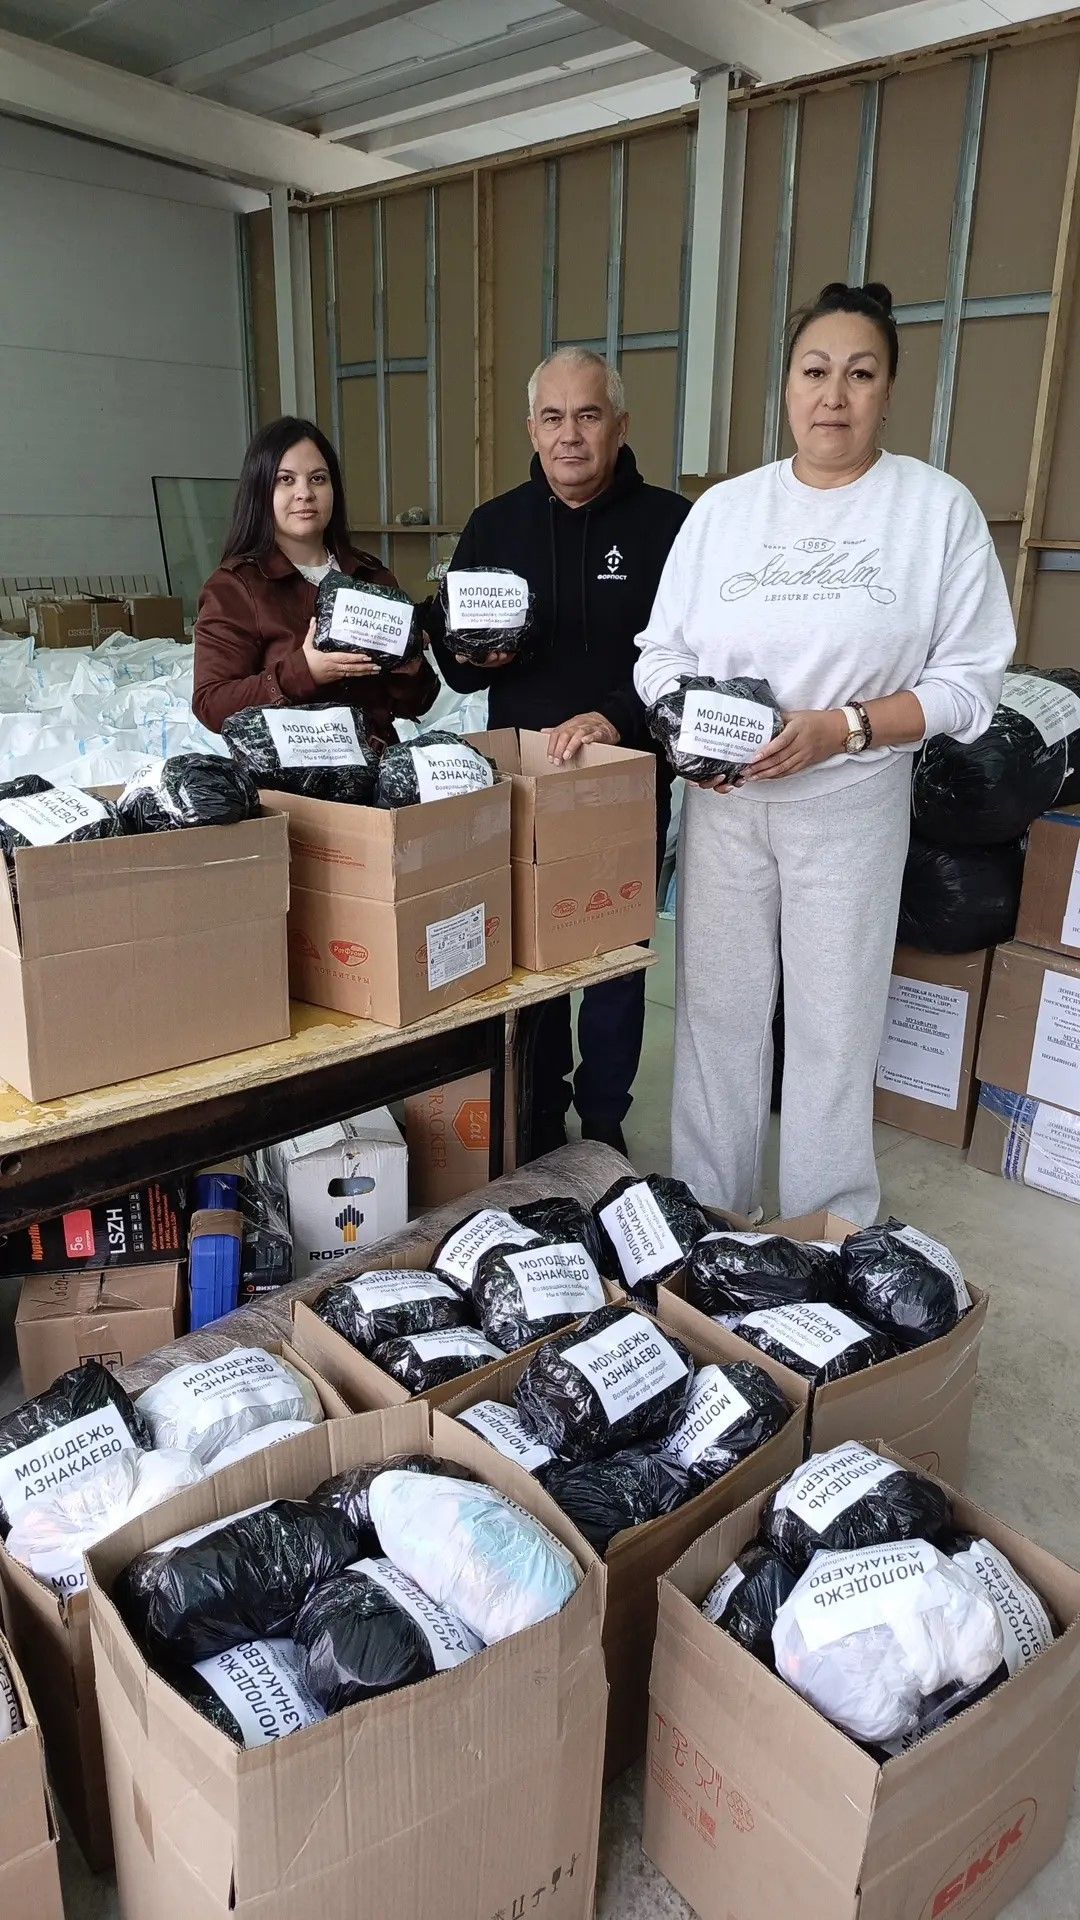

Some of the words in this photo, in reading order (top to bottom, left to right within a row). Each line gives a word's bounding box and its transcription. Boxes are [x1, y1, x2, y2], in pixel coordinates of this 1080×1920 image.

[802, 541, 827, 550] 1985
[459, 586, 522, 598] МОЛОДЕЖЬ
[726, 548, 888, 600] Stockholm
[344, 604, 404, 626] МОЛОДЕЖЬ
[459, 598, 522, 609] АЗНАКАЕВО
[764, 593, 809, 603] LEISURE
[812, 592, 841, 601] CLUB
[342, 616, 402, 637] АЗНАКАЕВО
[282, 722, 349, 735] МОЛОДЕЖЬ
[287, 733, 353, 745] АЗНАКАЕВО
[694, 722, 763, 744] АЗНАКАЕВО
[696, 708, 765, 731] МОЛОДЕЖЬ
[427, 758, 489, 777] МОЛОДЕЖЬ
[70, 1236, 83, 1251] 5e
[106, 1208, 126, 1254] LSZH
[445, 1213, 500, 1263] МОЛОДЕЖЬ
[458, 1219, 510, 1270] АЗНАКАЕВО
[616, 1204, 644, 1265] МОЛОДЕЖЬ
[623, 1196, 657, 1257] АЗНАКАЕВО
[518, 1254, 586, 1270] МОЛОДЕЖЬ
[526, 1268, 590, 1283] АЗНАКАЕВО
[768, 1306, 834, 1344] ЗНАКАЕВО
[182, 1355, 266, 1389] МОЛОДЕЖЬ
[588, 1331, 650, 1374] МОЛОДЕЖЬ
[601, 1343, 661, 1390] АЗНАКАЕВО
[192, 1363, 275, 1397] АЗНАКАЕВО
[472, 1408, 531, 1456] МОЛОДЕЖЬ
[14, 1422, 115, 1482] МОЛОДЕЖЬ
[23, 1437, 123, 1501] АЗНАКАЕВО
[796, 1450, 872, 1501] АЗНАКАЕВО
[807, 1456, 888, 1510] МОЛОДЕЖЬ
[809, 1550, 921, 1589] АЗНАКАЕВО
[813, 1560, 925, 1608] МОЛОДЕЖЬ
[377, 1564, 455, 1652] МОЛОДЕЖЬ
[984, 1556, 1042, 1655] ЗНАКАЕВО
[931, 1813, 1026, 1920] БКК
